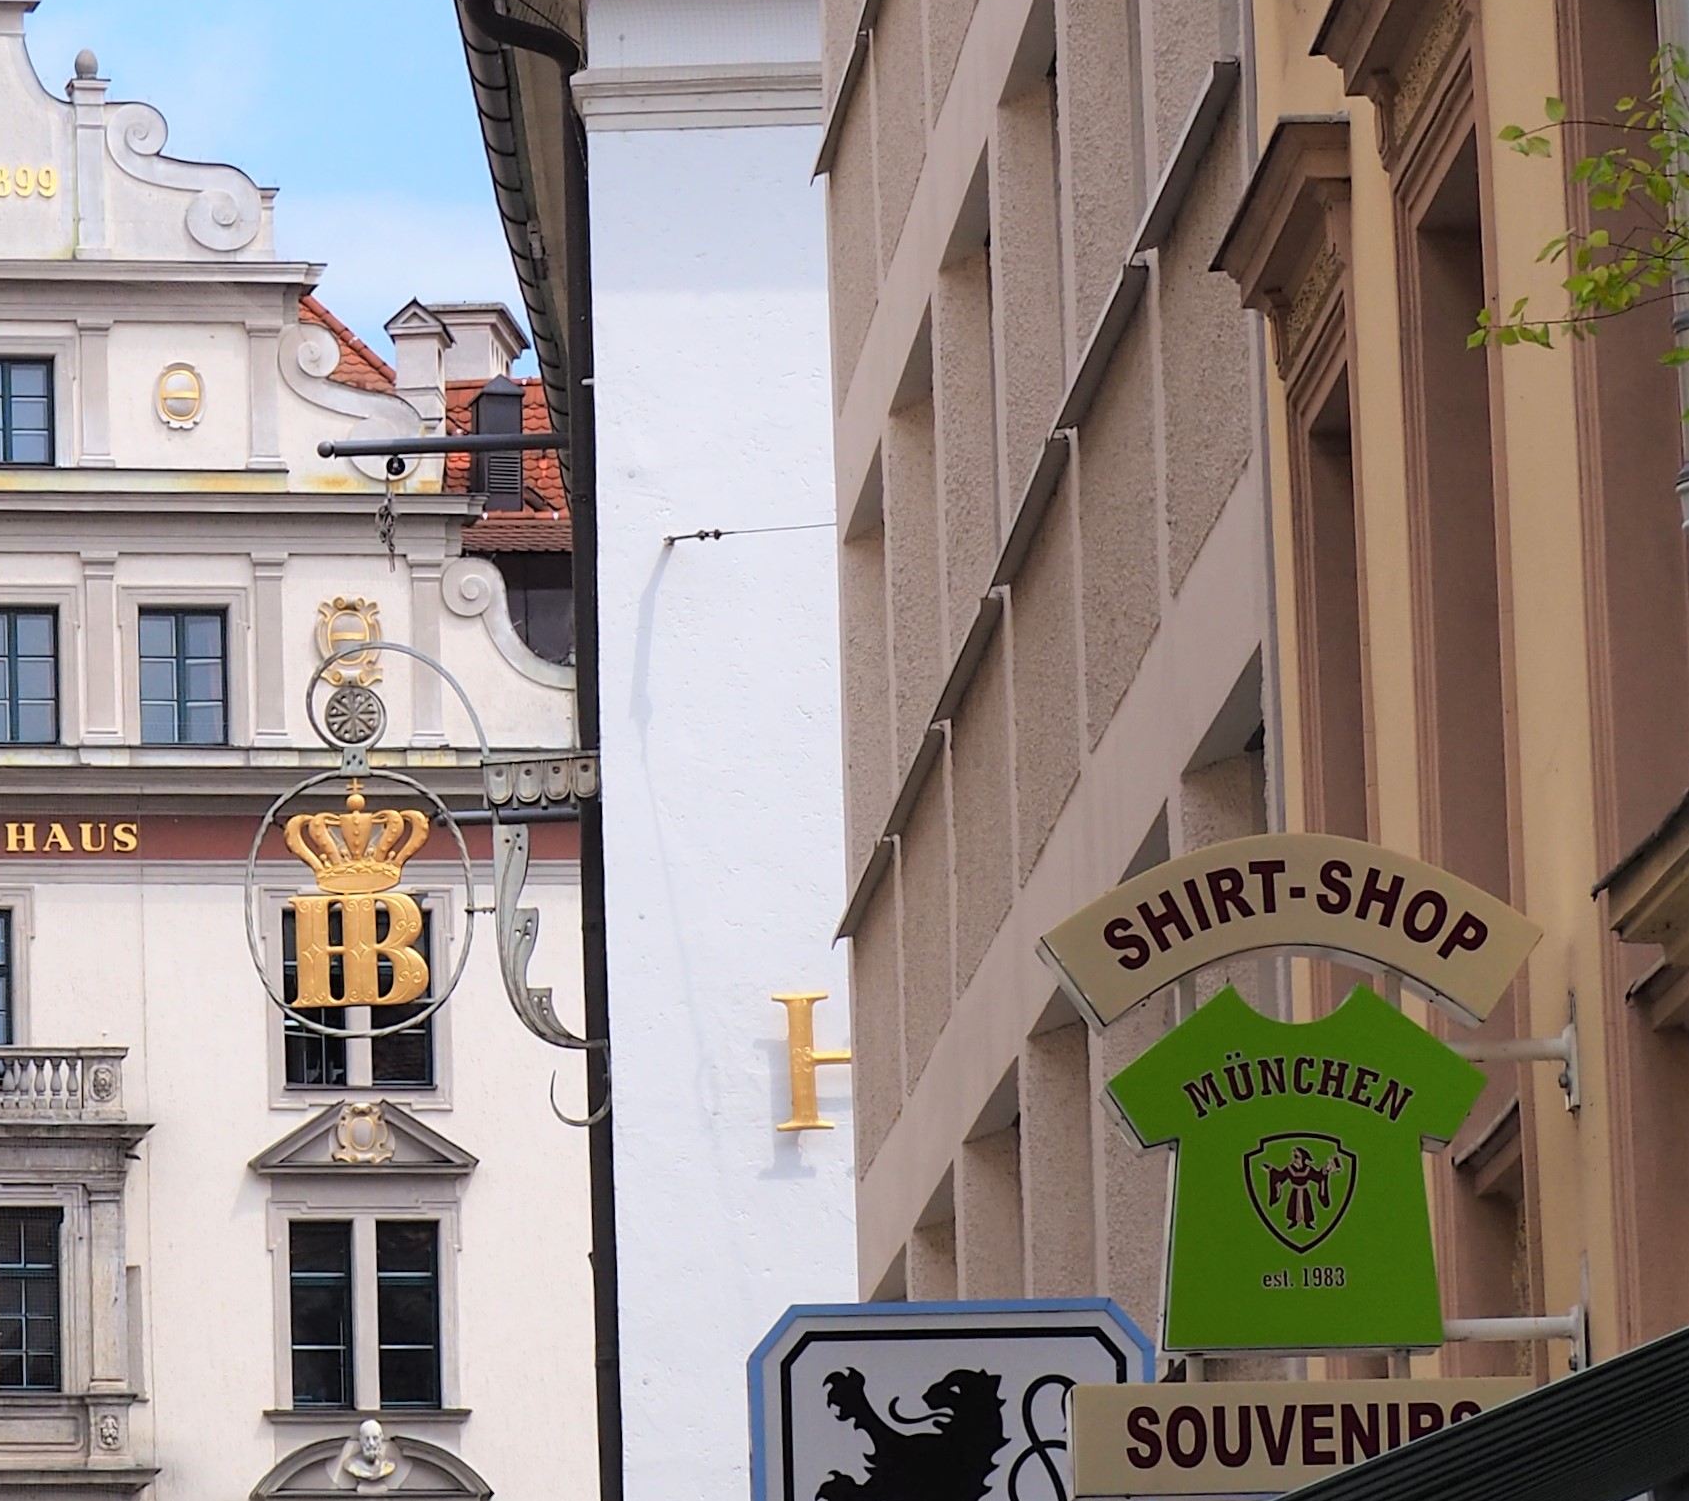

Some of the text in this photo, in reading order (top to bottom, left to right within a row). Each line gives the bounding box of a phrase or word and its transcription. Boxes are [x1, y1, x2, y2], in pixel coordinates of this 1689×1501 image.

[4, 821, 139, 853] HAUS
[290, 892, 430, 1008] HB
[1102, 859, 1488, 971] SHIRT-SHOP
[1183, 1051, 1414, 1123] MÜNCHEN
[1262, 1266, 1346, 1288] est. 1983
